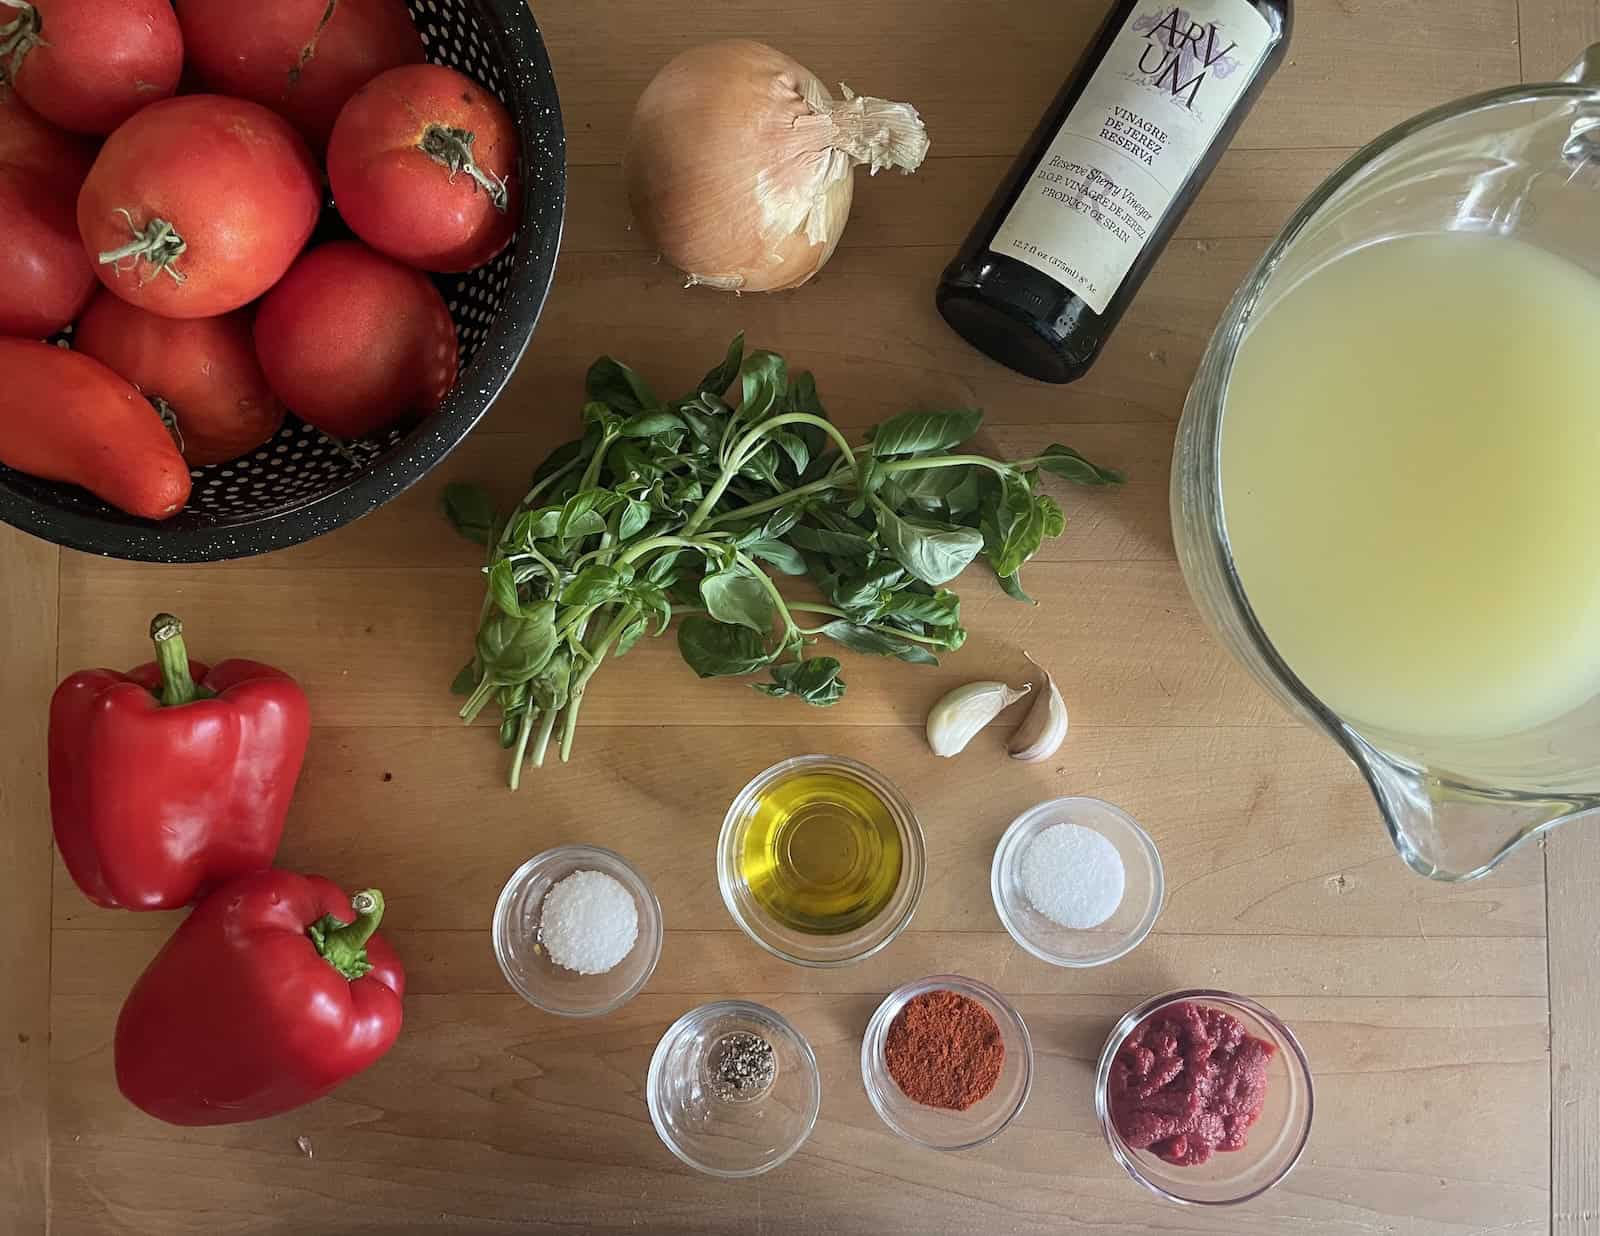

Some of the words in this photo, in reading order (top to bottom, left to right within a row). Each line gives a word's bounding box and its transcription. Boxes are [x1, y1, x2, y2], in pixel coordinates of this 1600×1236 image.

[1144, 7, 1238, 69] ARV
[1137, 43, 1207, 111] UM
[1099, 128, 1153, 166] RESERVA
[1104, 117, 1123, 133] DE
[1123, 127, 1162, 156] JEREZ
[1114, 106, 1168, 144] VINAGRE
[1041, 187, 1092, 214] PRODUCT
[1090, 209, 1106, 222] OF
[1103, 219, 1131, 244] SPAIN
[1048, 155, 1088, 177] Reserve
[1086, 168, 1122, 197] Sherry
[1121, 188, 1153, 222] Vinegar
[1064, 178, 1111, 208] VINAGRE
[1108, 202, 1124, 217] DE
[1121, 213, 1147, 239] JEREZ
[1012, 239, 1030, 250] 12.7
[1037, 251, 1050, 261] oz
[1048, 255, 1080, 280] (375ml)
